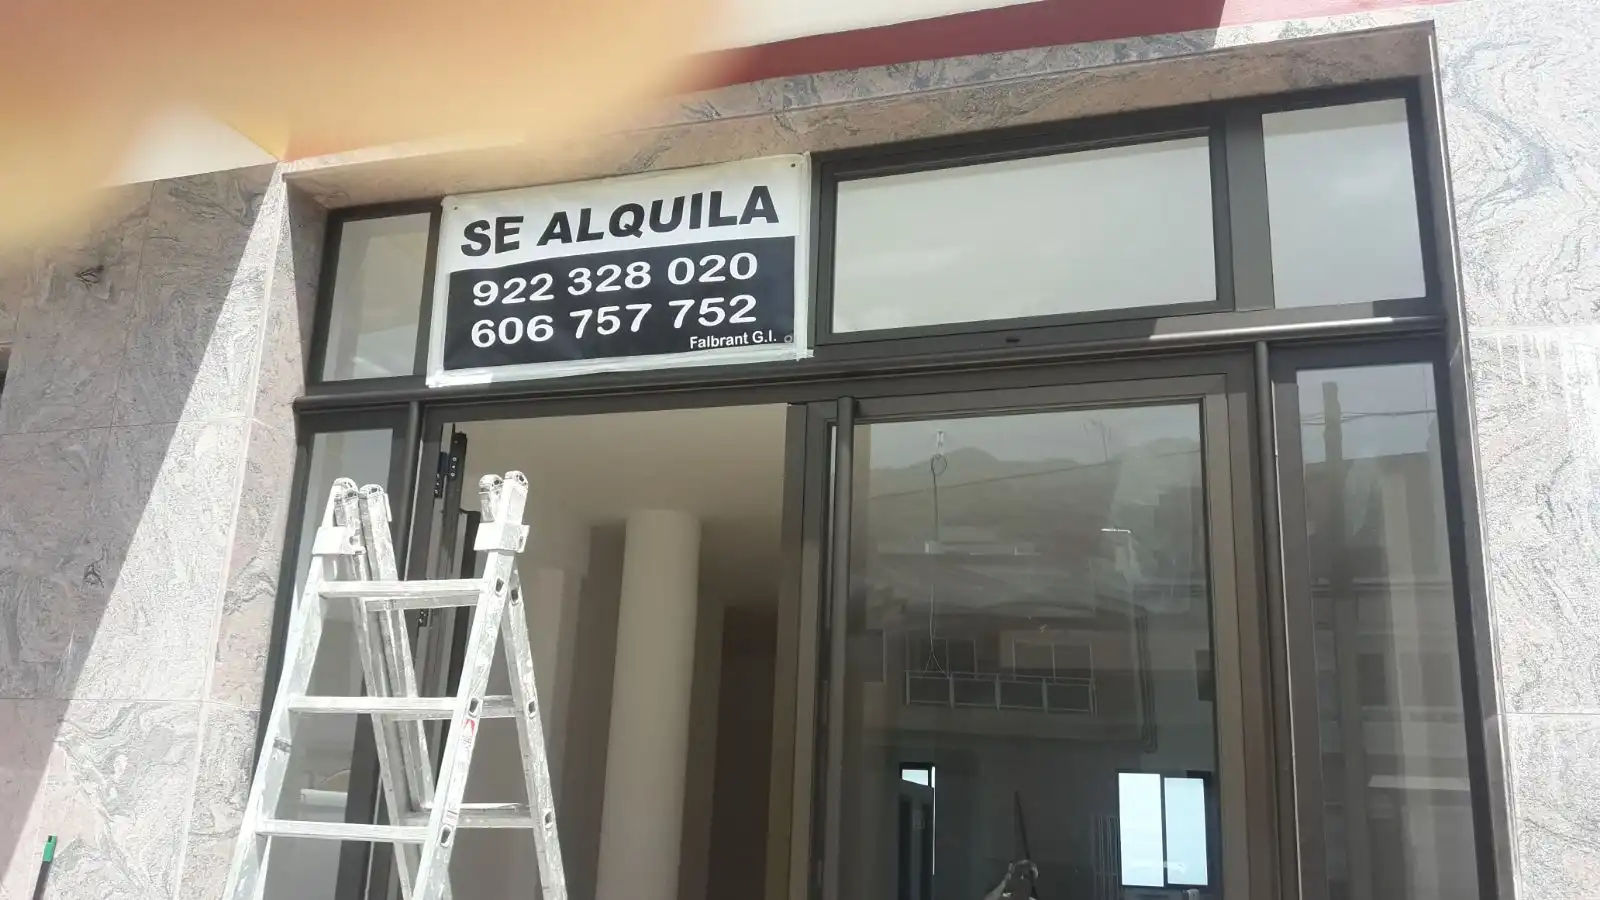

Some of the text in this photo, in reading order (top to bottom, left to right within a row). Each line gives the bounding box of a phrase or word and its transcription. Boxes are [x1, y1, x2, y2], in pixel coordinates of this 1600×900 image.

[461, 185, 779, 257] SE ALQUILA
[472, 252, 758, 306] 922 328 020
[471, 294, 757, 348] 606 757 752
[690, 329, 777, 349] Falbrant G.I.
